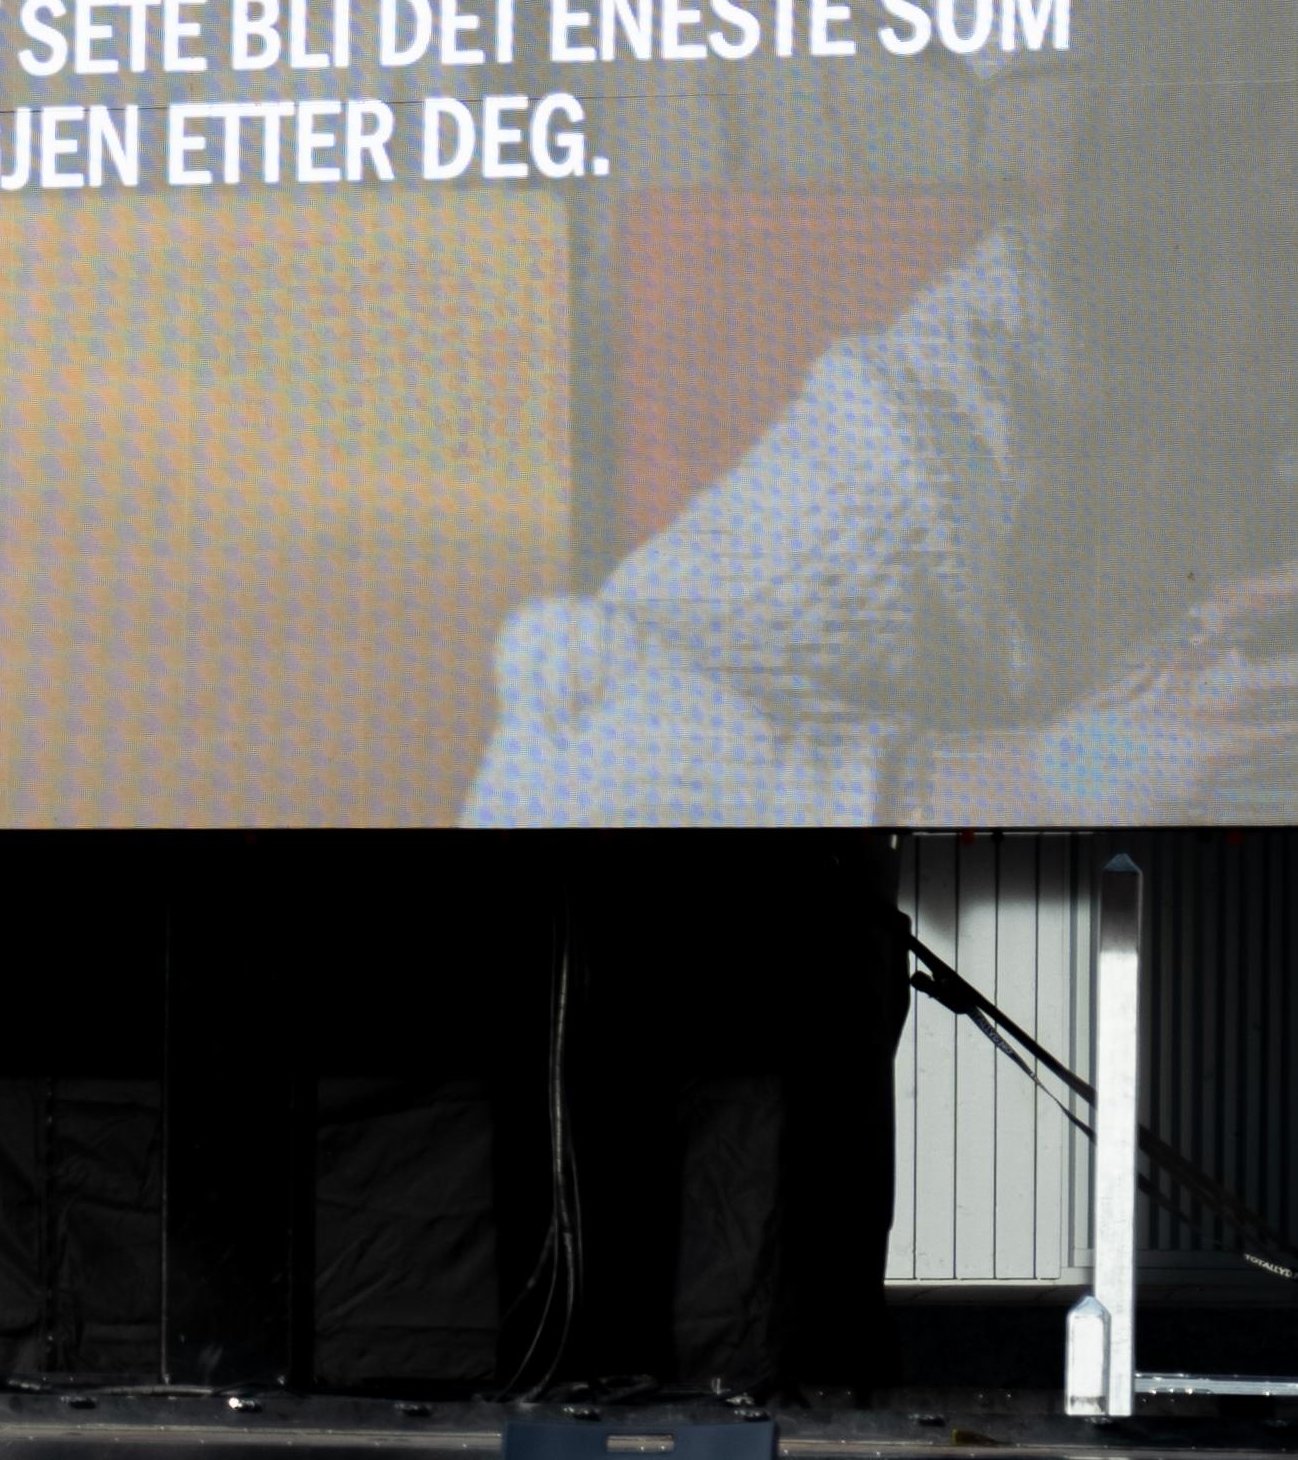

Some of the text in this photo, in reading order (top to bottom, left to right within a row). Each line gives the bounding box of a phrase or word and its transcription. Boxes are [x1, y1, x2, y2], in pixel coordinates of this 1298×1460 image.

[168, 98, 394, 186] ETTER
[422, 93, 610, 180] DEG.
[1244, 1253, 1298, 1279] TOTALLYD
